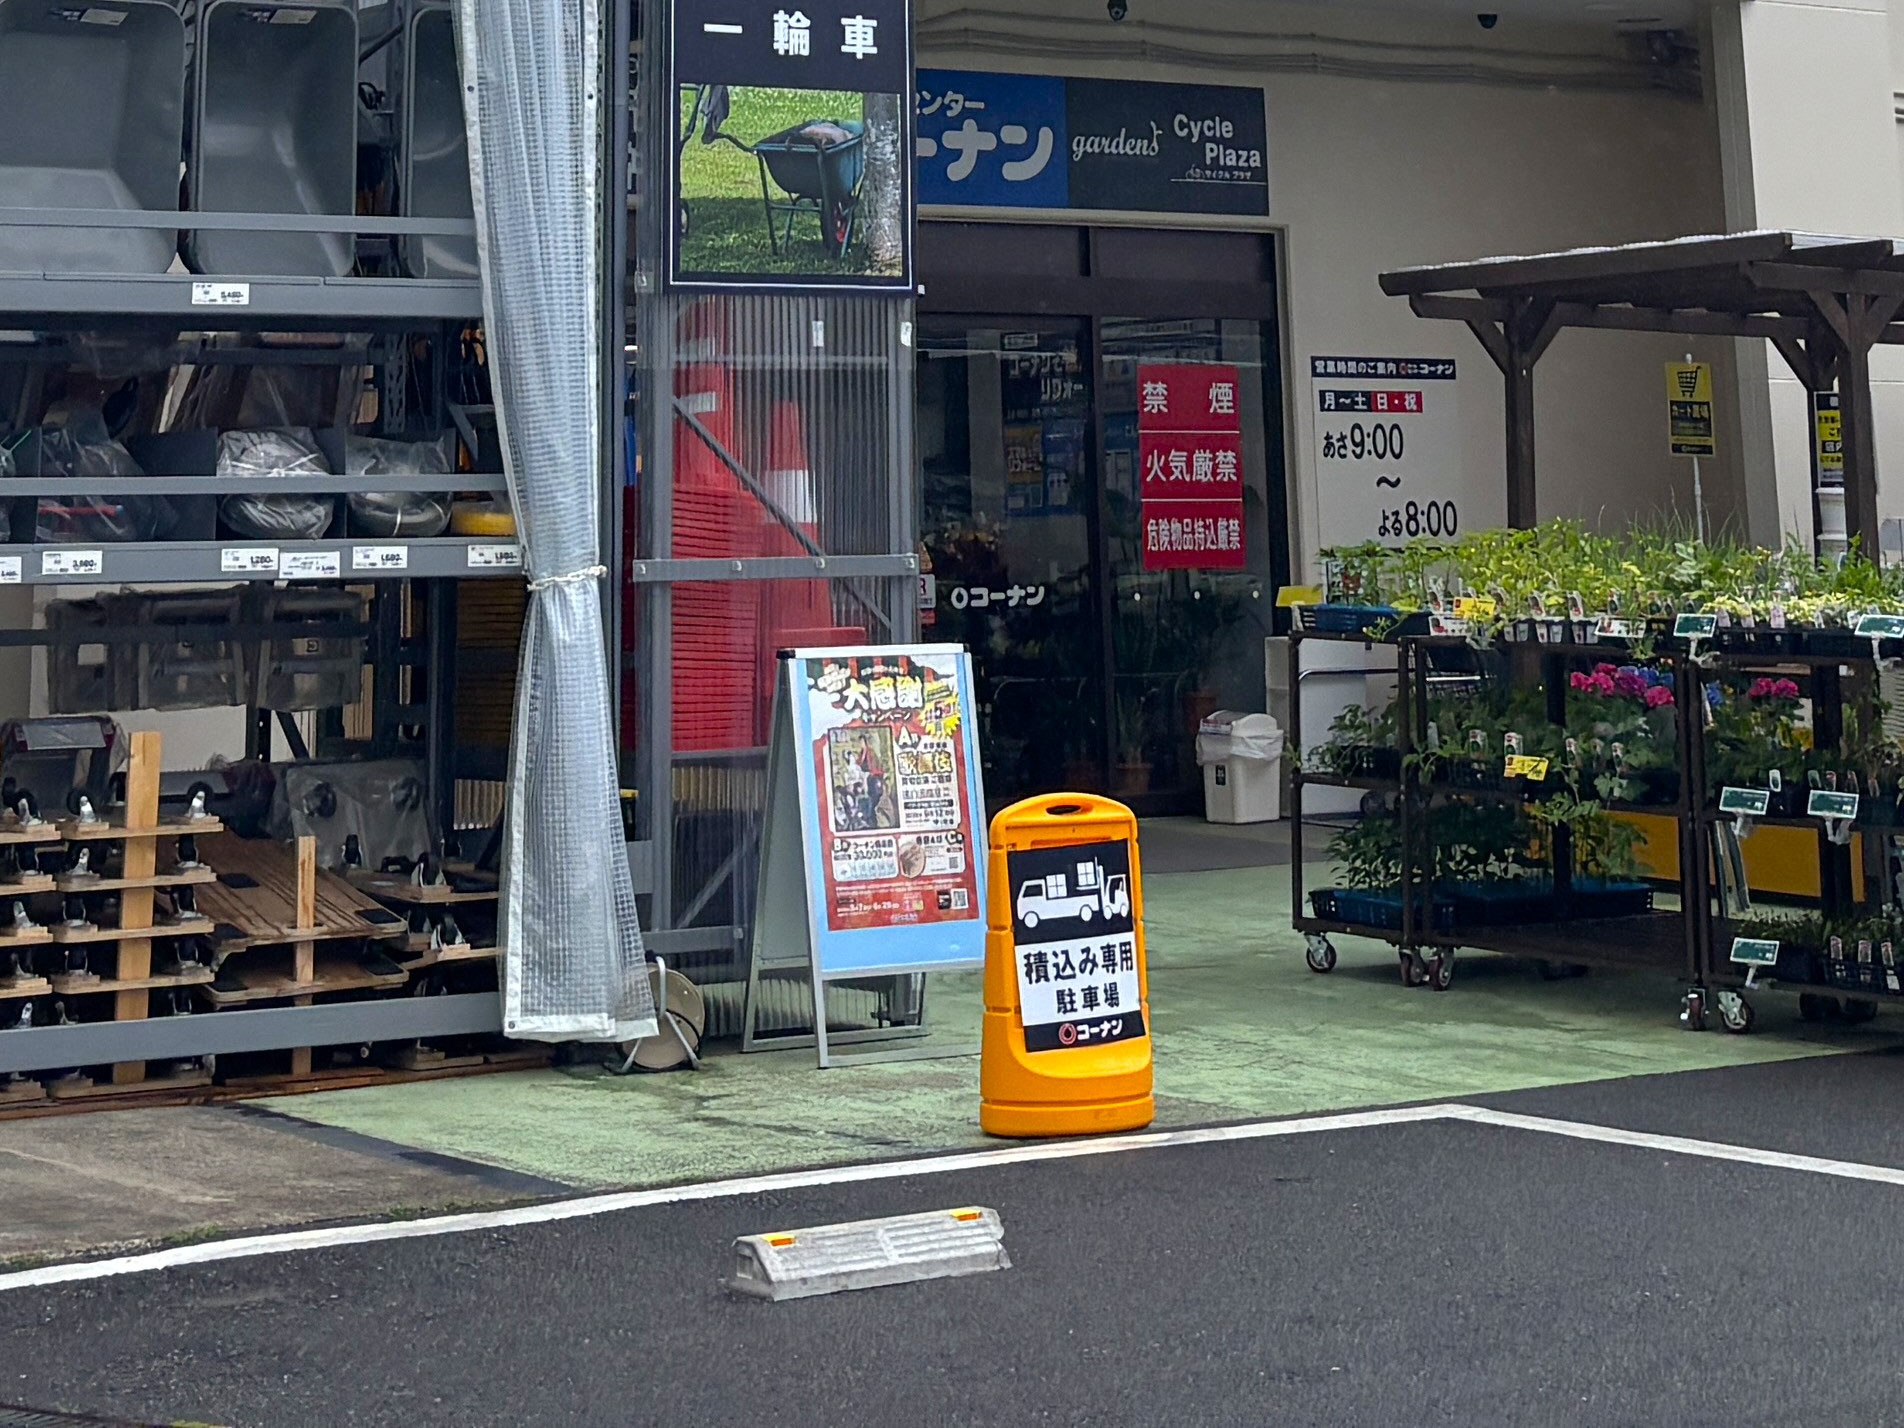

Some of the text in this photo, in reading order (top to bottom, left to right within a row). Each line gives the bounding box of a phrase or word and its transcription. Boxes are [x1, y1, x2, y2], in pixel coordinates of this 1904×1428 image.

[704, 10, 878, 59] 一輪車
[1173, 113, 1233, 143] Cycle
[1205, 142, 1261, 168] Plaza
[1314, 360, 1397, 375] 営業時間のご案内
[1419, 363, 1454, 375] コーナン
[1143, 381, 1234, 414] 禁煙
[1376, 392, 1418, 411] 日・祝
[1146, 449, 1238, 482] 火気厳禁
[1147, 517, 1241, 551] 危険物品持込厳禁
[970, 585, 1044, 607] コーナン
[1023, 941, 1134, 984] 積込み専用
[1056, 982, 1120, 1014] 駐車場
[1077, 1018, 1123, 1041] コーナン
